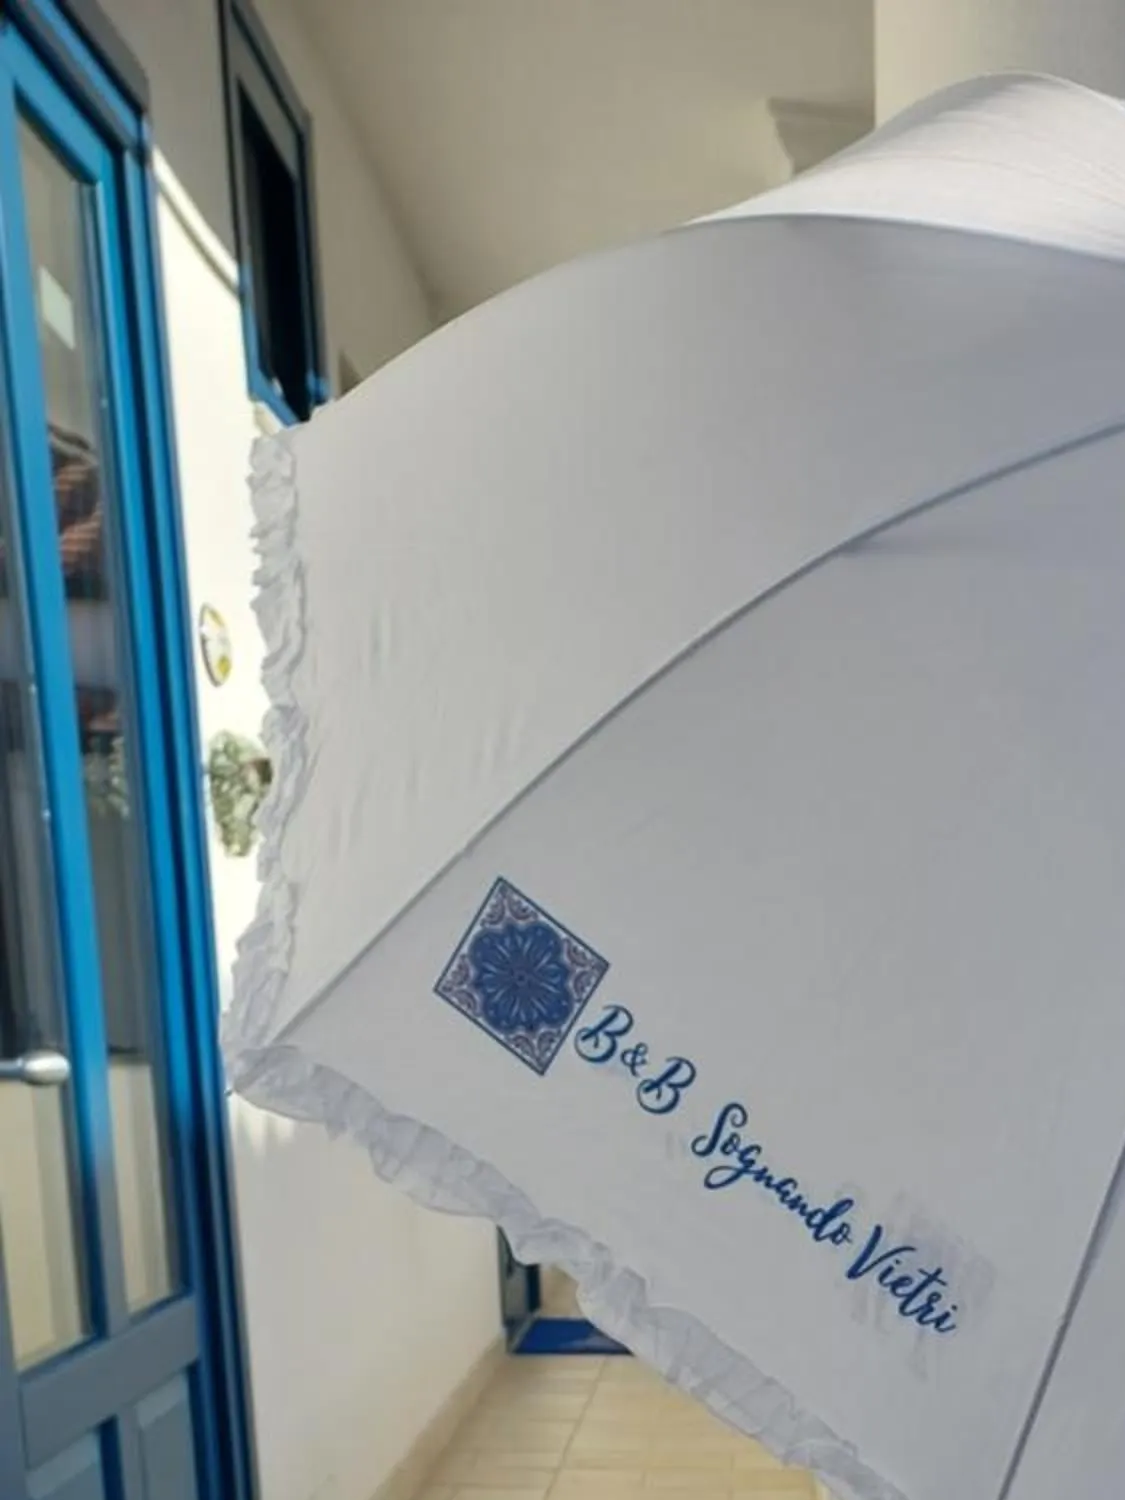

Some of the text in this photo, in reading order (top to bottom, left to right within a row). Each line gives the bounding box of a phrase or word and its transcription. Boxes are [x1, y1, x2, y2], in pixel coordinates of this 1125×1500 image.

[574, 1004, 958, 1335] B&B Sognando Vietri
